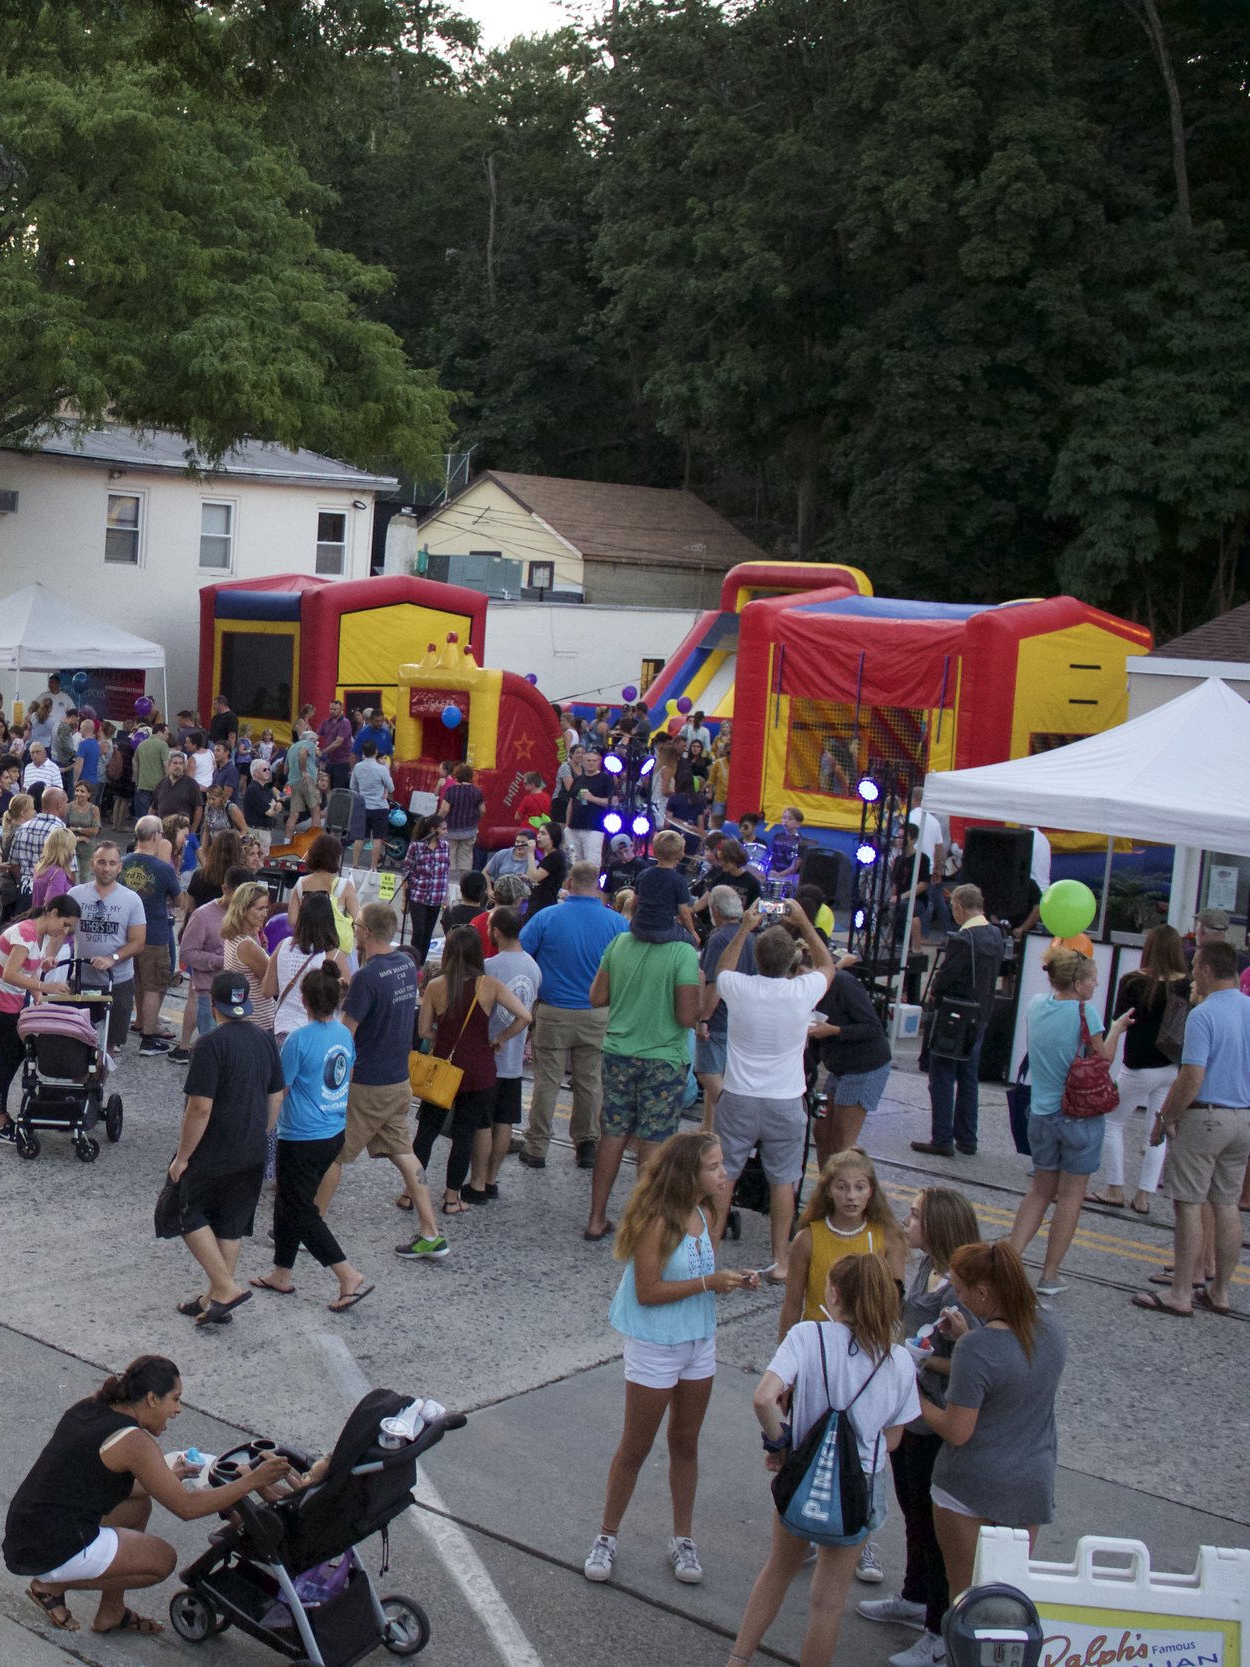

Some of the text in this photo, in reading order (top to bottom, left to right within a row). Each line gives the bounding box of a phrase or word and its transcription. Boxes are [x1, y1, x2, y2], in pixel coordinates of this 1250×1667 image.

[136, 872, 156, 882] Rock
[81, 902, 97, 912] THIS
[86, 912, 111, 920] FIST
[106, 922, 119, 934] DAY
[86, 934, 108, 942] SHIRT
[379, 969, 392, 978] BMW
[392, 964, 409, 974] MAKES
[396, 972, 406, 980] CAR
[394, 987, 406, 996] MAKE
[800, 1446, 835, 1522] PINK
[1042, 1630, 1196, 1667] Ralph's Famous
